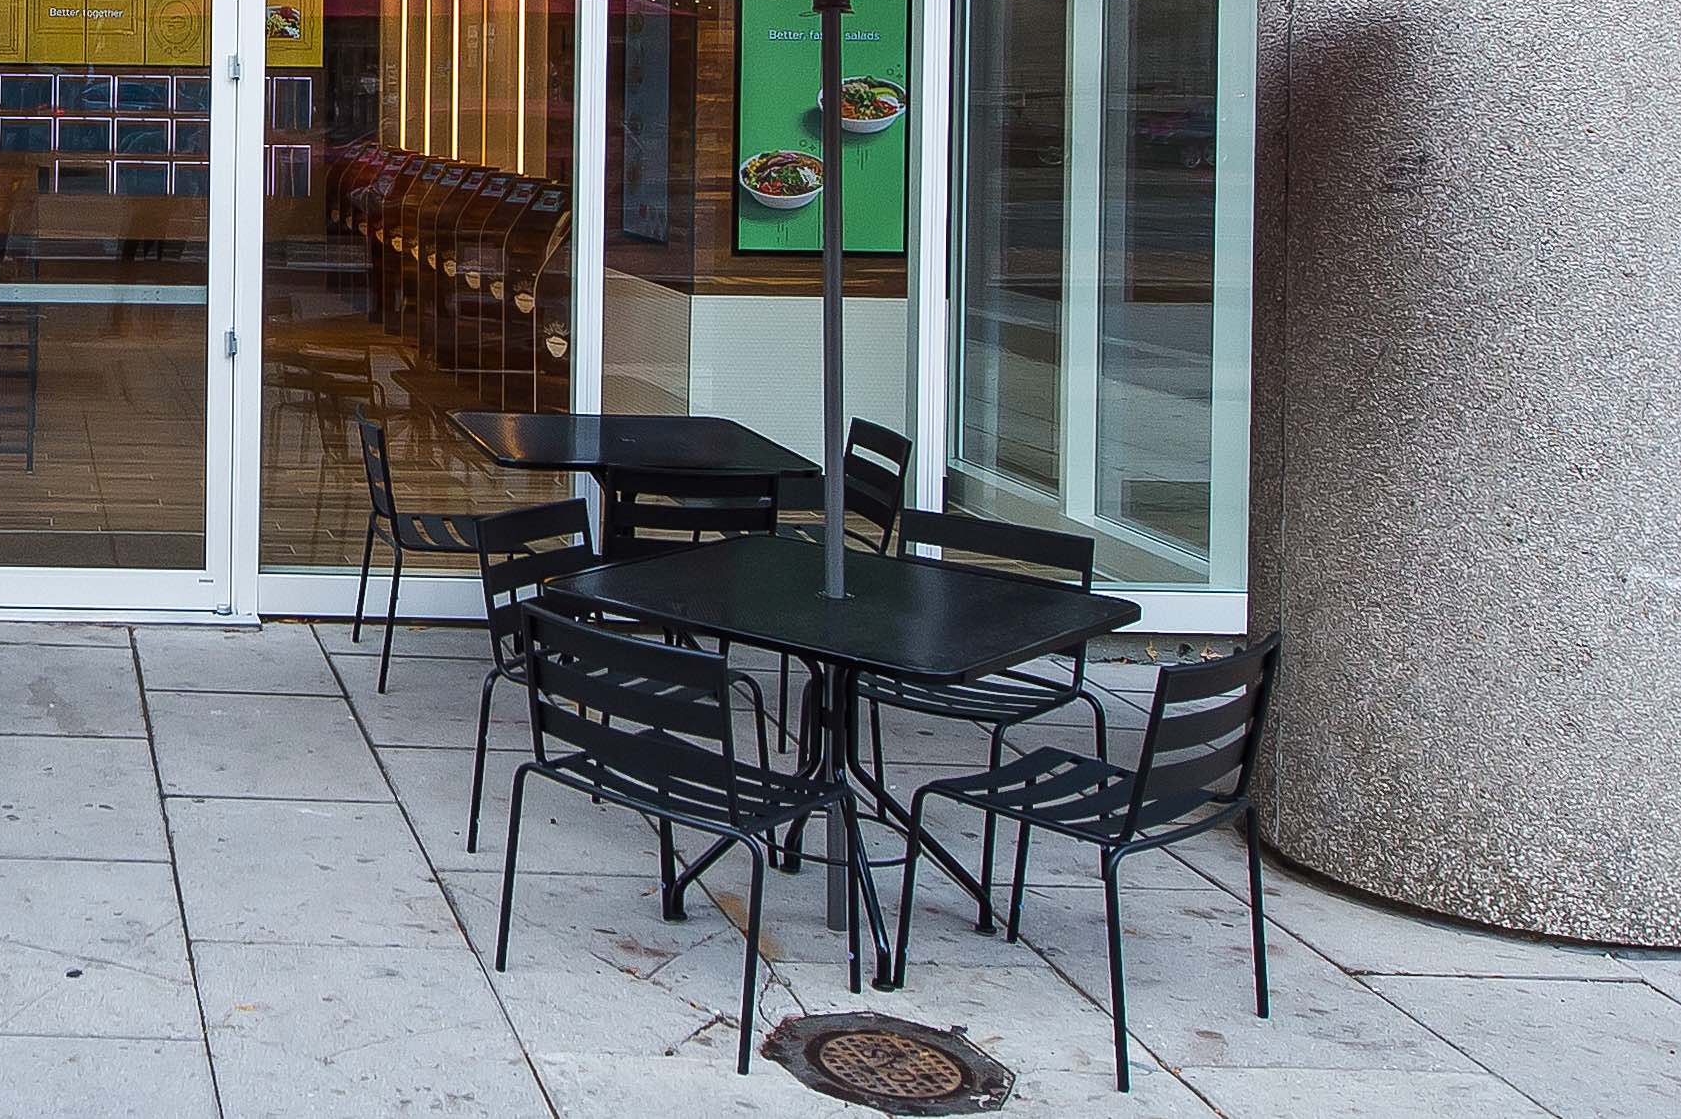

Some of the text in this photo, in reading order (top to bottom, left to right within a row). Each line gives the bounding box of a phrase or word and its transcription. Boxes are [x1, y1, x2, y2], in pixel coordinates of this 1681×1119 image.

[49, 7, 124, 19] Better together
[844, 29, 880, 41] salads
